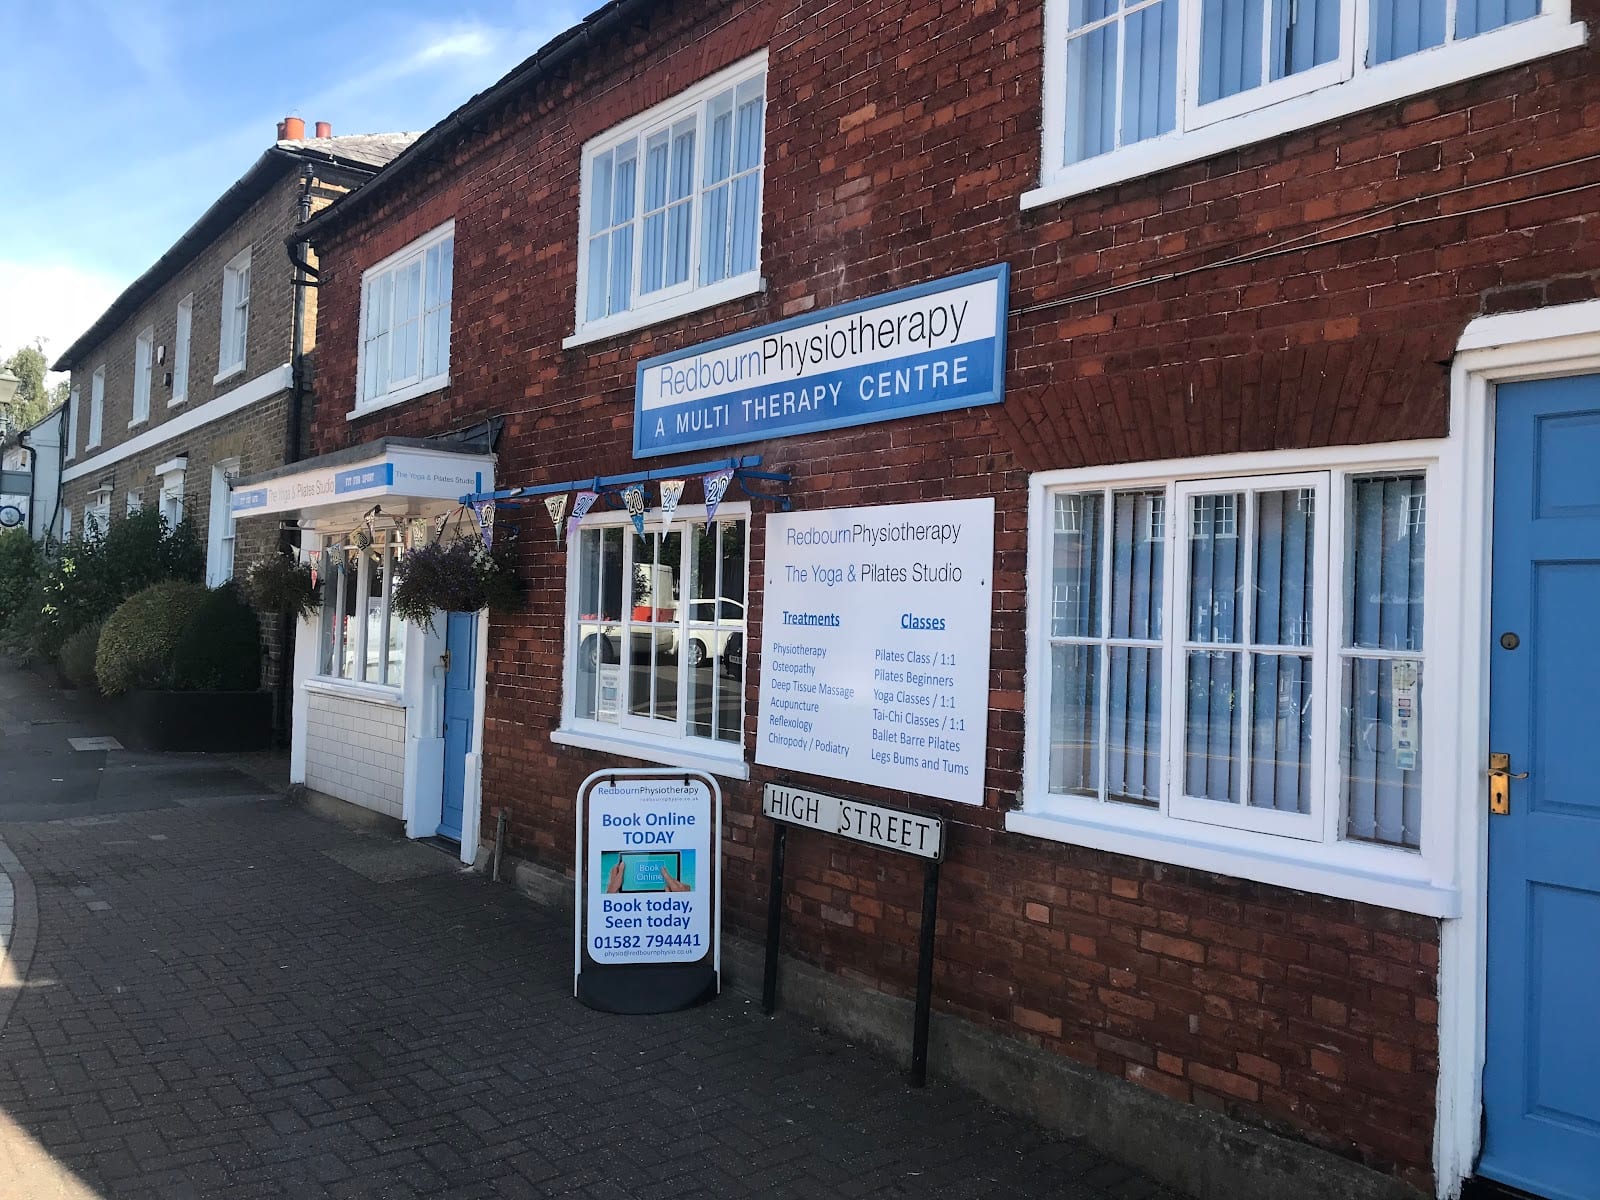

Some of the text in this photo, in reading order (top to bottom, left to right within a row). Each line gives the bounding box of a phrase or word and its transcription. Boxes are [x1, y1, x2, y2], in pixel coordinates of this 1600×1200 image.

[655, 356, 969, 438] A MULTI THERAPY CENTRE
[410, 472, 425, 481] Yoga
[433, 475, 454, 483] Pilates
[455, 477, 475, 485] Studio
[663, 485, 681, 512] 20
[703, 476, 730, 505] 20
[573, 494, 595, 518] 20
[625, 490, 645, 516] 20
[480, 504, 495, 528] 20
[785, 562, 962, 587] The Yoga & Pilates Studio
[782, 611, 840, 626] Treatments
[900, 613, 946, 631] Classes
[773, 642, 827, 659] Physiotherapy
[875, 649, 956, 667] Pilates Class / 1:1
[772, 660, 816, 677] Osteopathy
[771, 678, 855, 698] Deep Tissue Massage
[874, 669, 954, 688] Pilates Beginners
[770, 697, 820, 713] Acupuncture
[873, 688, 956, 709] Yoga Classes / 1:1
[769, 714, 813, 733] Reflexology
[873, 708, 965, 731] Tai-Chi Classes / 1:1
[768, 732, 850, 757] Chiropody / Podiatry
[872, 728, 960, 752] Ballet Barre Pilates
[871, 748, 969, 776] Legs Bums and Tums
[602, 812, 696, 827] Book Online
[771, 789, 930, 850] HIGH STREET
[623, 831, 675, 844] TODAY
[639, 864, 660, 872] Book
[636, 874, 663, 882] Online
[603, 898, 693, 913] Book today,
[605, 914, 691, 929] Seen today
[594, 934, 702, 949] 01582 794441
